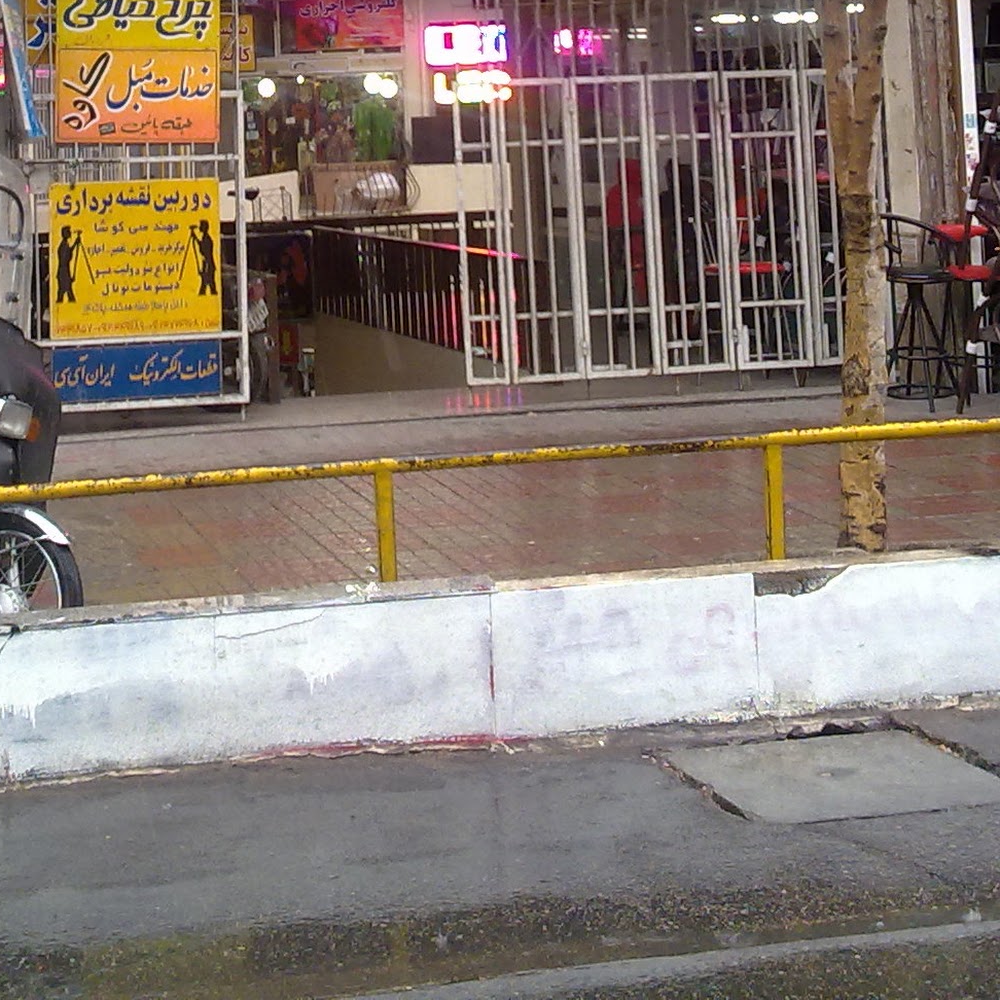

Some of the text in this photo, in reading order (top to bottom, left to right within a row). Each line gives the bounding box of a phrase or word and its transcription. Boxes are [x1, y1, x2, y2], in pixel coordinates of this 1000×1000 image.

[139, 64, 214, 100] خدمات
[56, 185, 212, 216] دوربین نقشه برداری
[179, 352, 219, 381] قطعات
